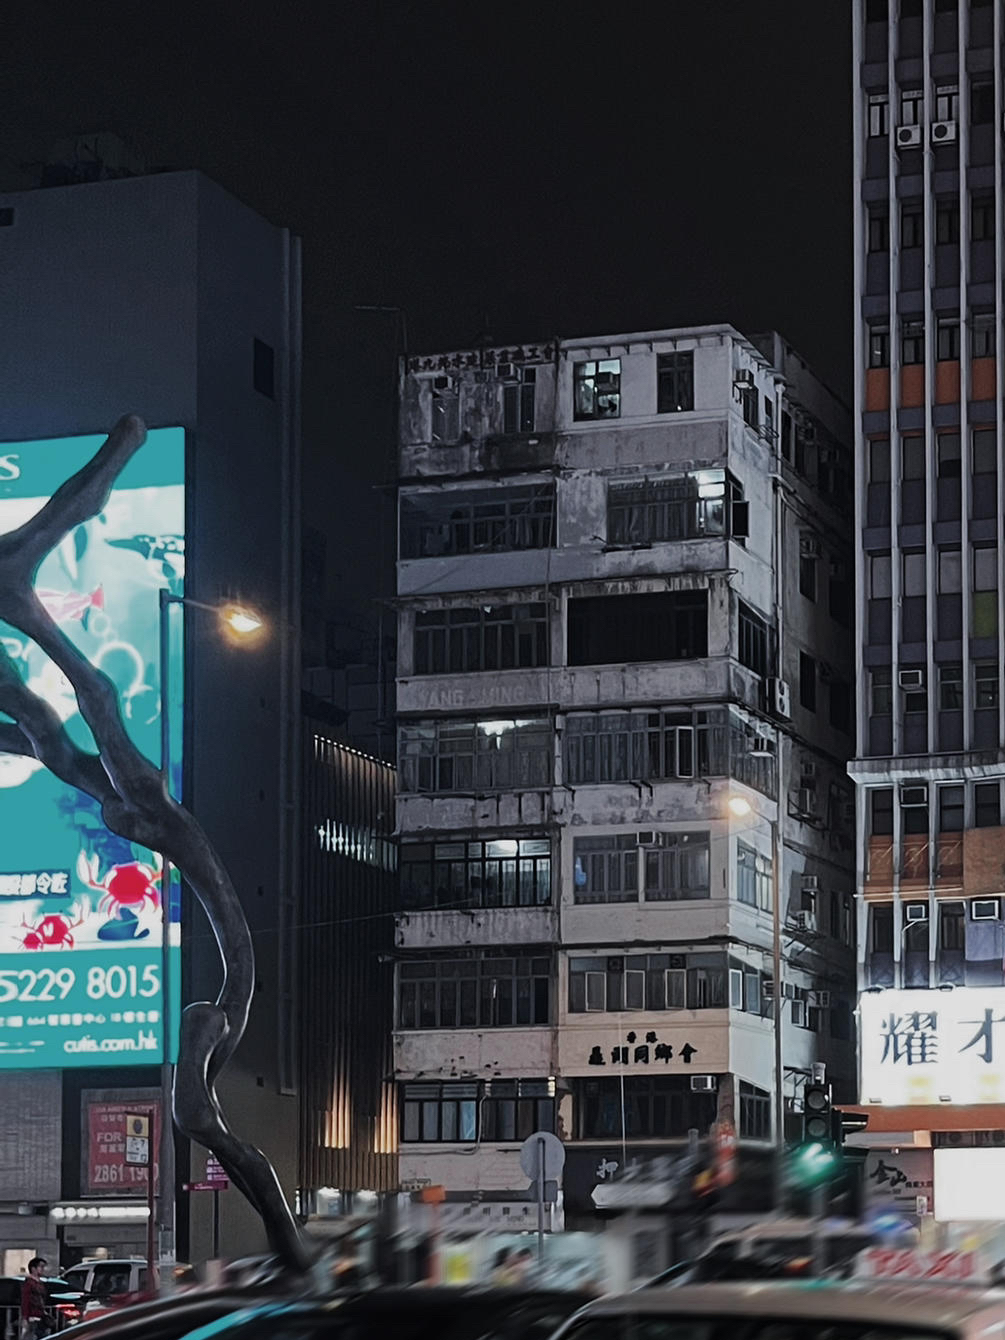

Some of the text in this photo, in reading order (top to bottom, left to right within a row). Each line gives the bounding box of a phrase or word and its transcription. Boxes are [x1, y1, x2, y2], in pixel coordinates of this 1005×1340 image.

[86, 964, 161, 1000] 8015
[63, 1029, 158, 1053] cutis.com.hk
[94, 1164, 124, 1183] 2861
